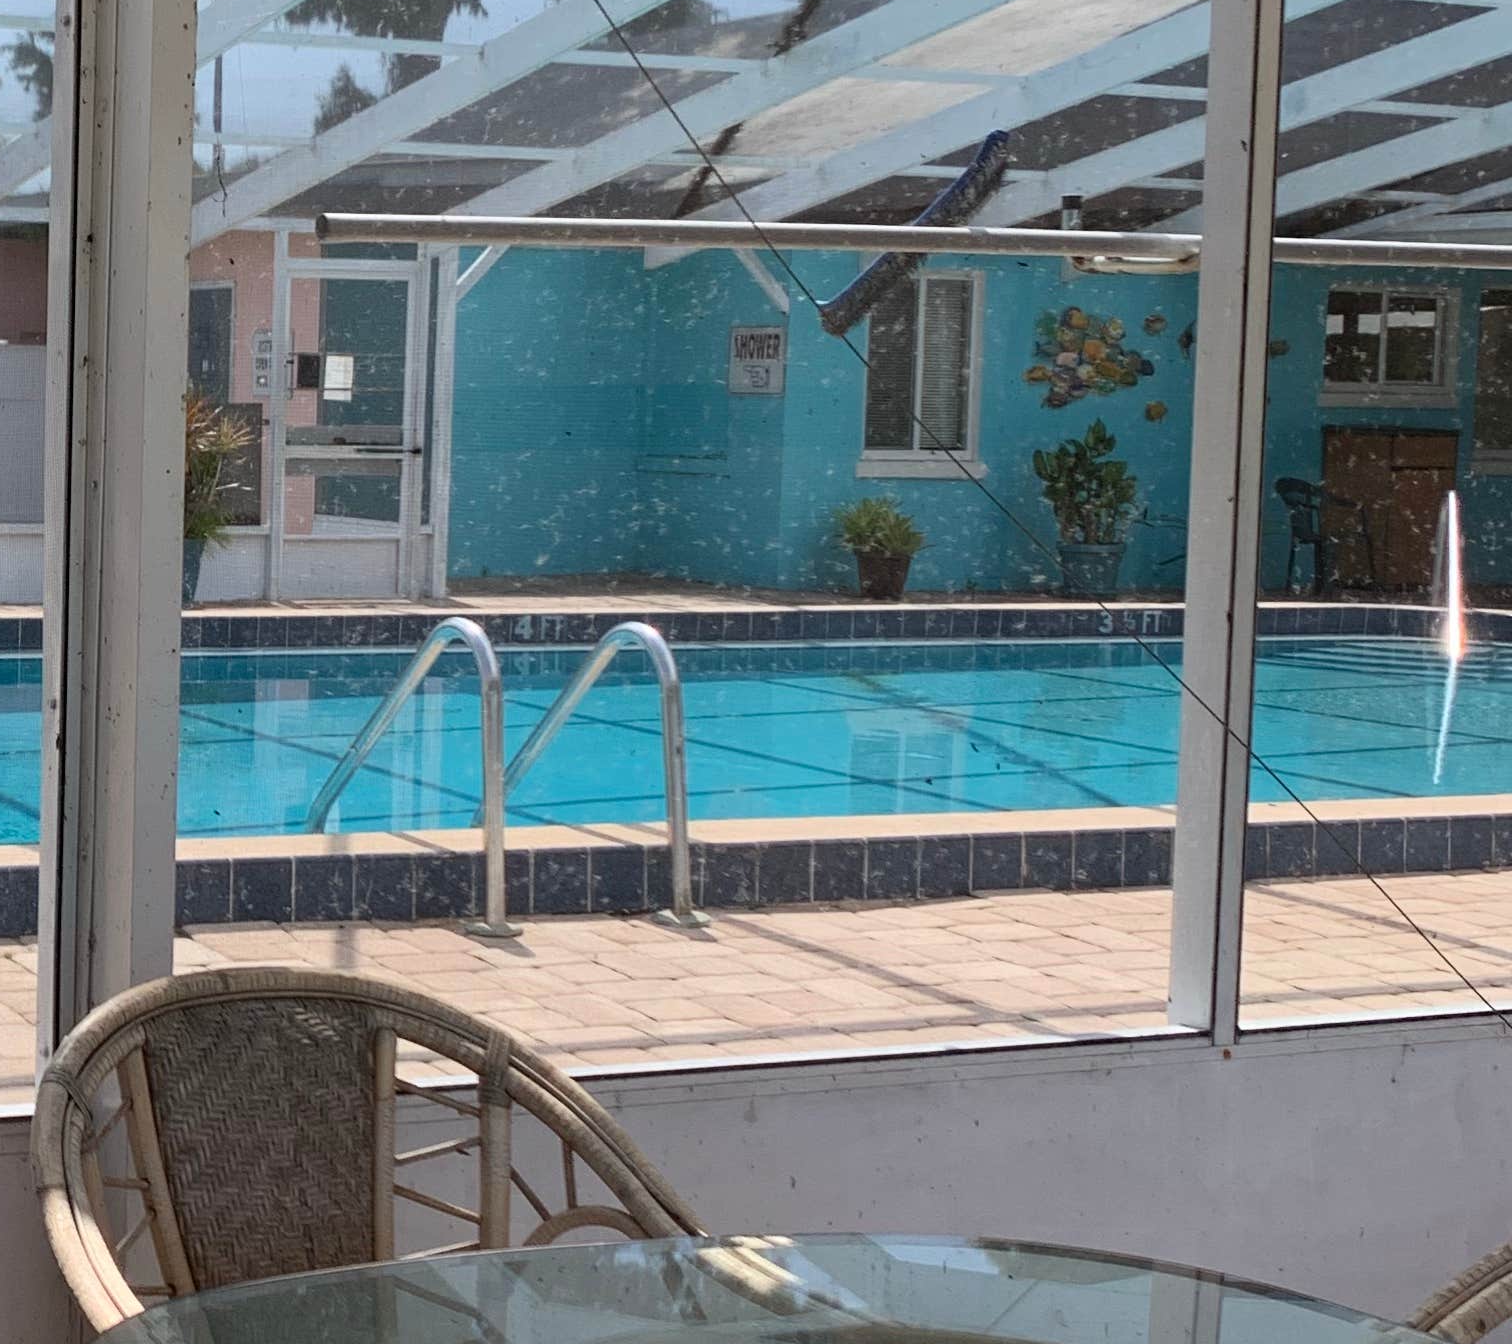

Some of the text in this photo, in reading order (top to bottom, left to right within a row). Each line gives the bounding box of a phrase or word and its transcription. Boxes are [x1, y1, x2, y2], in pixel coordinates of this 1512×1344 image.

[734, 334, 780, 360] SHOWER
[514, 615, 532, 639] 4
[1098, 610, 1113, 633] 3
[1142, 610, 1162, 633] FT
